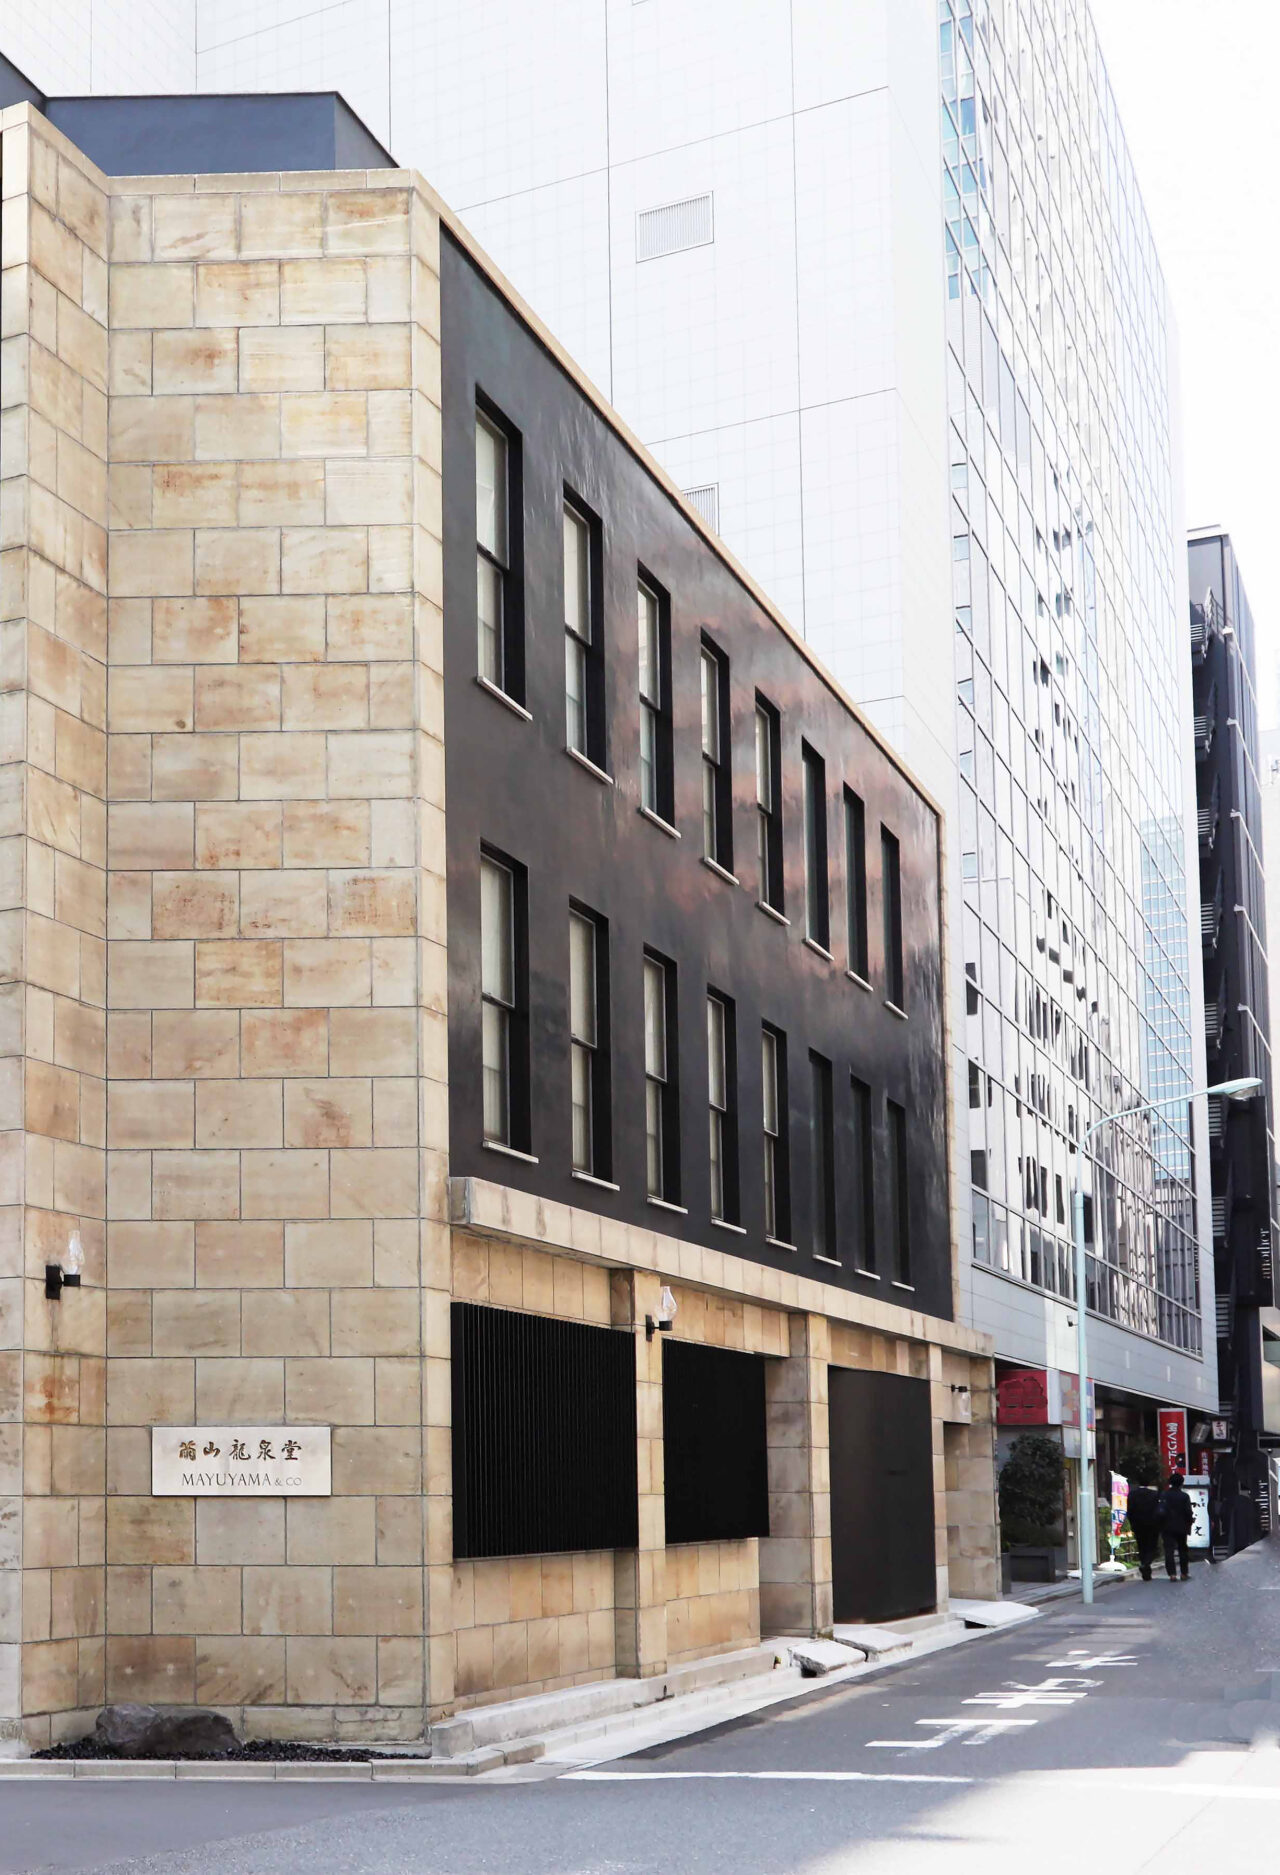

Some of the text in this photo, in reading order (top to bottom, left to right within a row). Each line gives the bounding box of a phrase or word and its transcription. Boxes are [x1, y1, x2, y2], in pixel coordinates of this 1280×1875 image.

[182, 1473, 302, 1486] MAYUYAMA & CO
